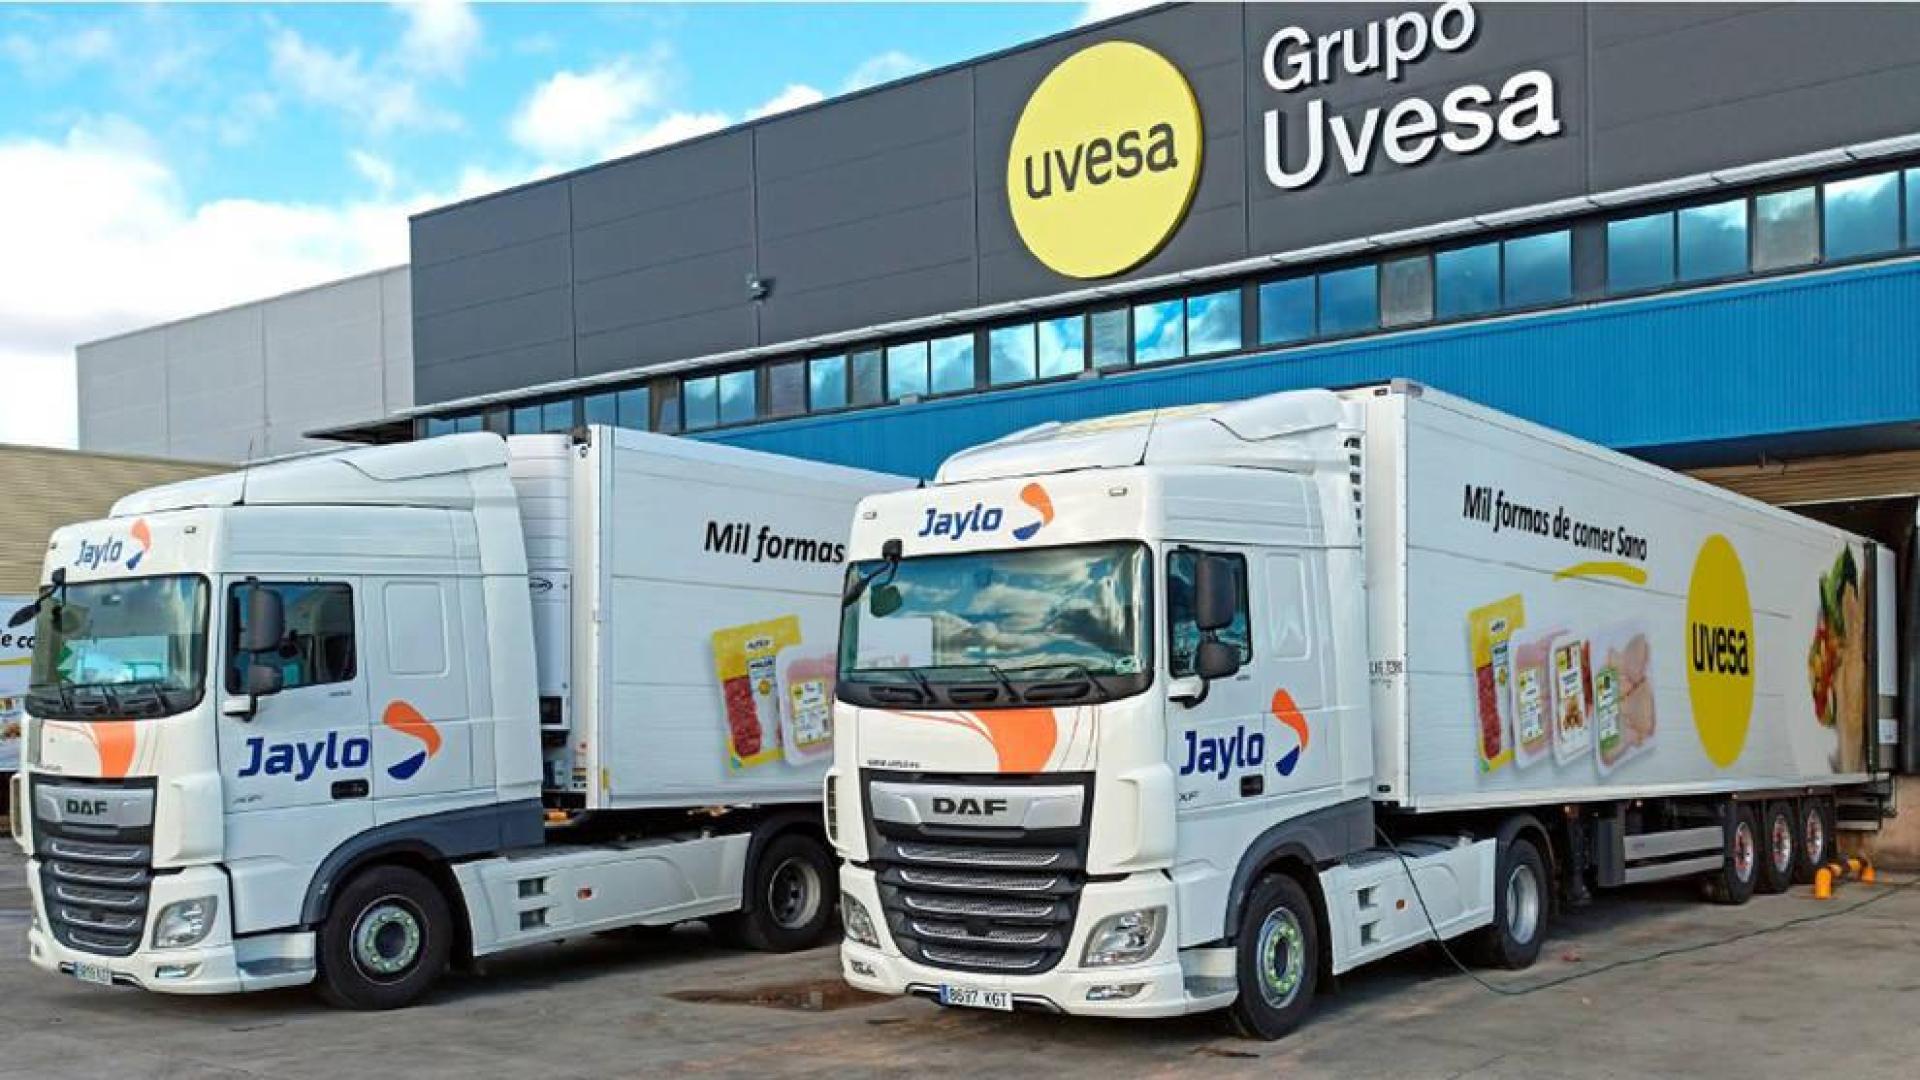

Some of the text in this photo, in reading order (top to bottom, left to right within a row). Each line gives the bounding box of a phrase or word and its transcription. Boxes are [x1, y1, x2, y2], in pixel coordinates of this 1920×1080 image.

[1262, 1, 1476, 91] Grupo
[1263, 69, 1561, 189] Uvesa
[1025, 122, 1178, 199] uvesa
[704, 520, 846, 563] Mil formas
[918, 502, 1003, 541] Jaylo
[1463, 484, 1647, 561] Mil formas de comer Sano
[74, 535, 122, 570] Jaylo
[1692, 621, 1749, 676] uvesa
[238, 730, 370, 782] Jaylo
[1179, 725, 1265, 780] Jaylo
[66, 799, 108, 815] DAF
[932, 798, 1008, 815] DAF
